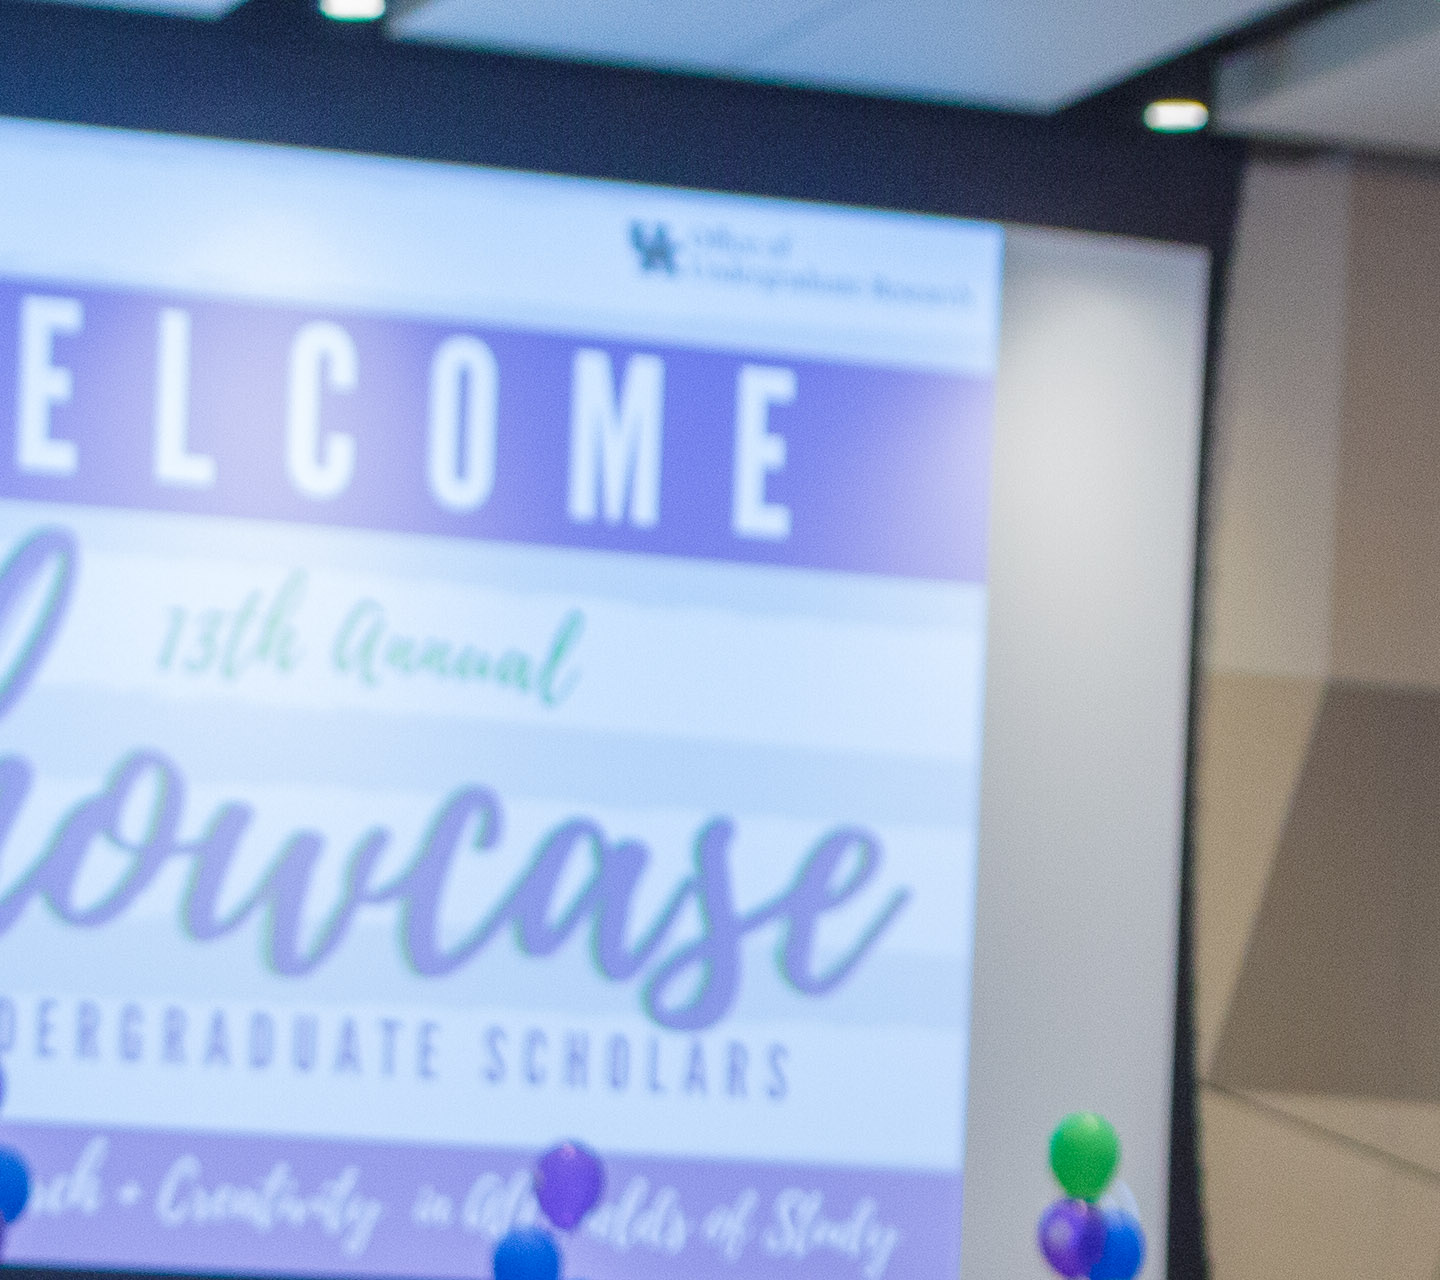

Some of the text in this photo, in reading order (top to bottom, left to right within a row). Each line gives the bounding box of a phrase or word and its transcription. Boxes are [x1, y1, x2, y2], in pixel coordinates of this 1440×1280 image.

[158, 572, 586, 708] 13th Annual
[480, 1023, 791, 1101] SCHOLARS
[153, 1155, 384, 1256] Creativity
[704, 1190, 757, 1263] of
